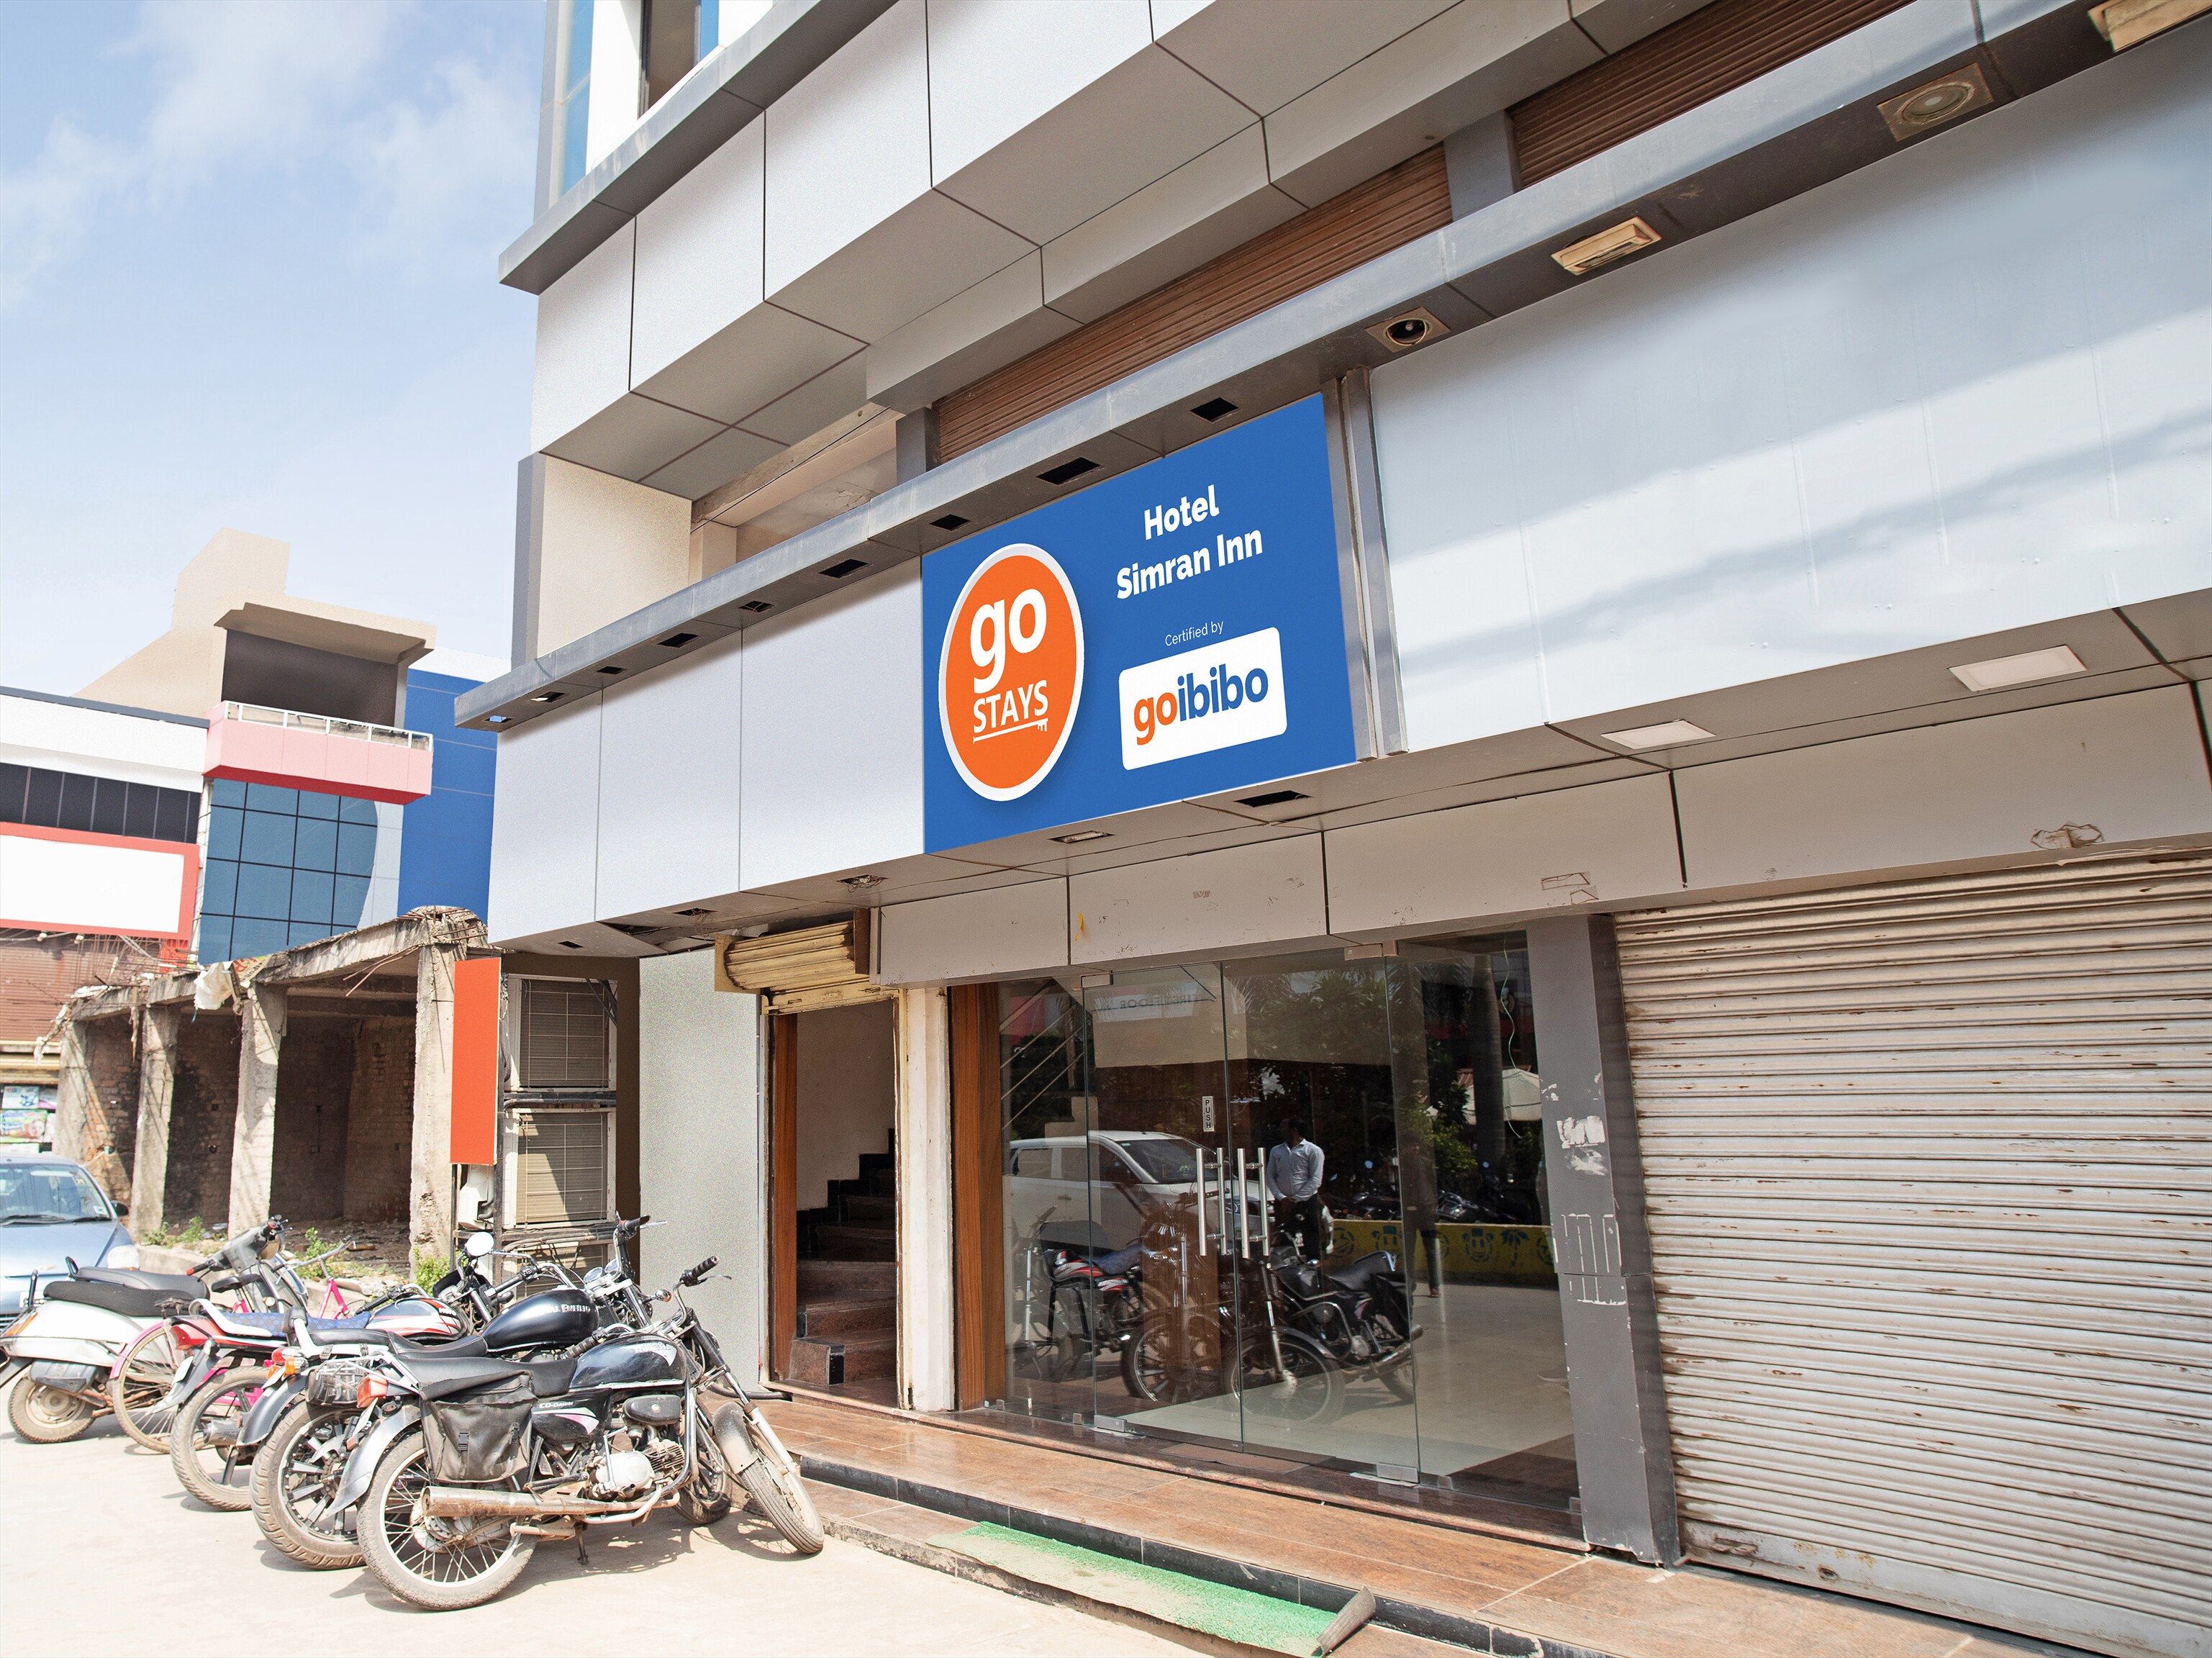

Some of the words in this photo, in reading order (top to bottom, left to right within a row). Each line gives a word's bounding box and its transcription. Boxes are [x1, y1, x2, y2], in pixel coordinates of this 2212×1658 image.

[1144, 484, 1220, 540] Hotel
[1117, 548, 1210, 599] Simran
[1217, 530, 1263, 567] Inn
[970, 588, 1047, 694] go
[1165, 622, 1208, 646] Certified
[1210, 621, 1223, 635] by
[973, 679, 1048, 733] STAYS
[1133, 663, 1269, 746] goibibo
